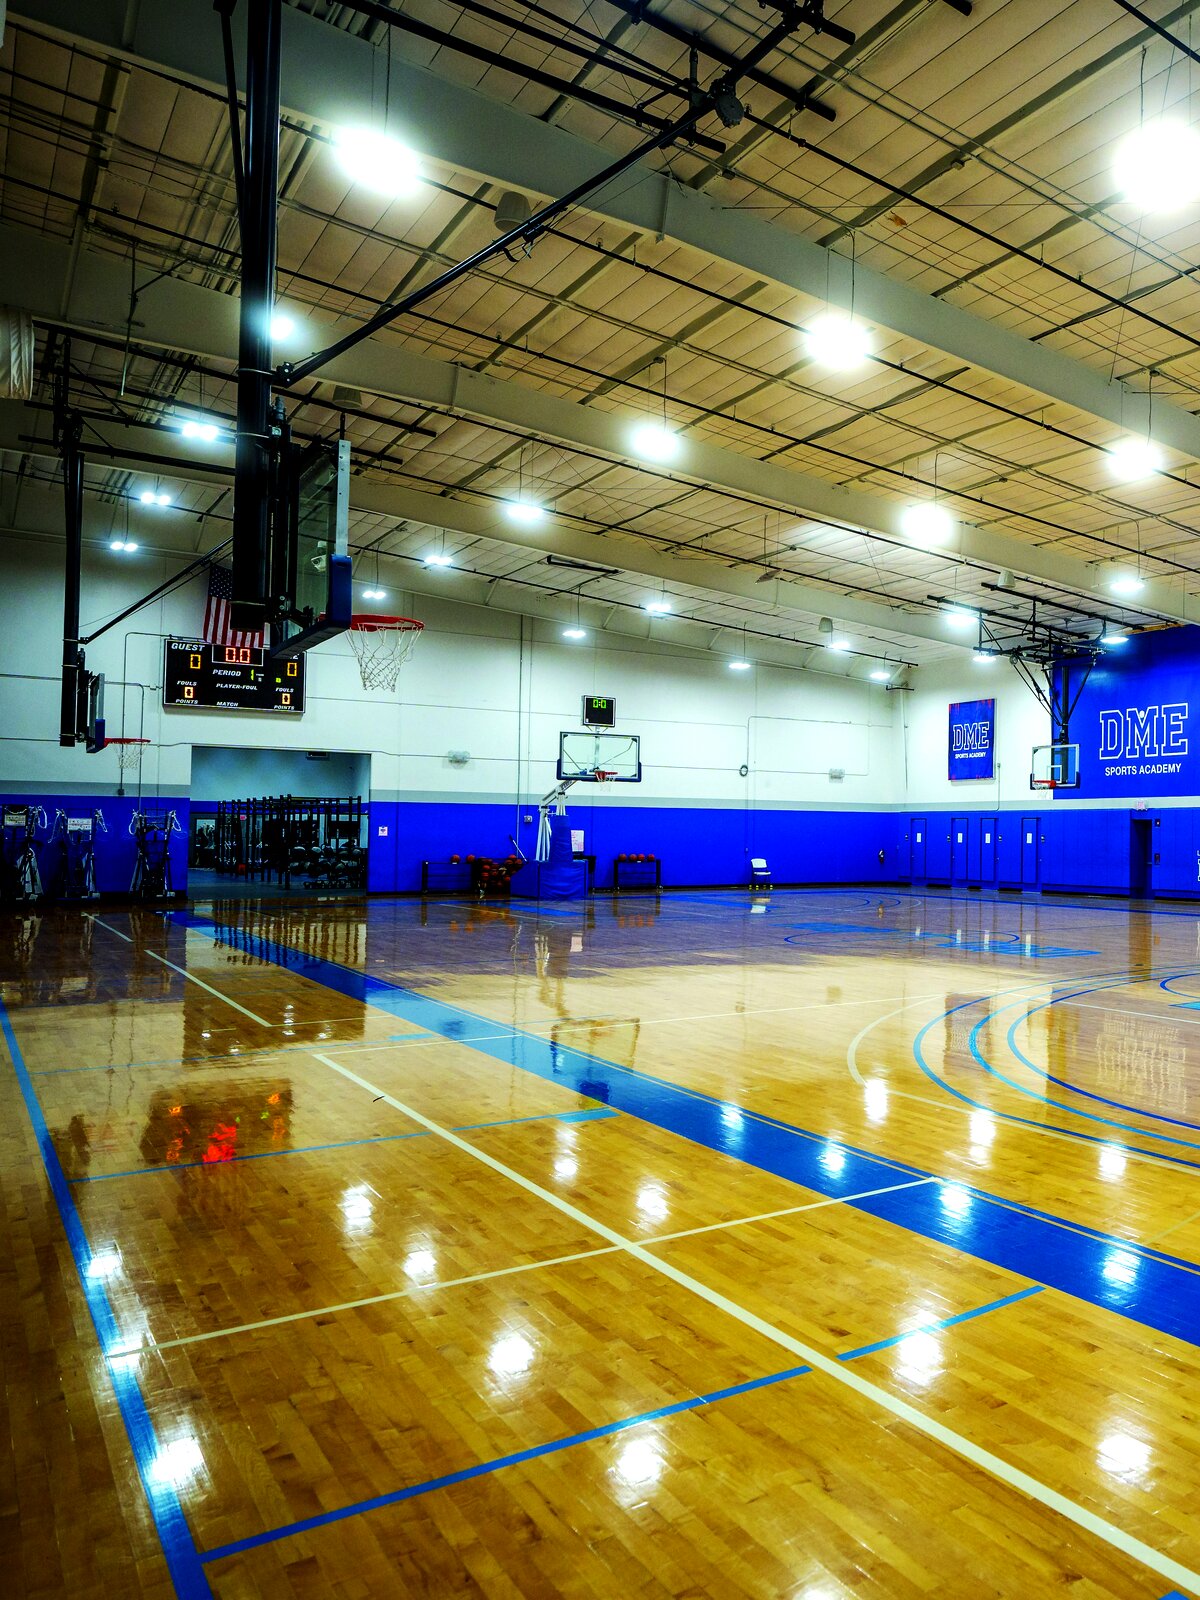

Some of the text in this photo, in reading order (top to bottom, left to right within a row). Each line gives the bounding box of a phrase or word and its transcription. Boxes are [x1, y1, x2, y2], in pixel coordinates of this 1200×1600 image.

[171, 643, 205, 652] GUEST
[190, 654, 201, 669] 0
[212, 669, 242, 677] PERIOD
[287, 662, 298, 677] 0
[216, 683, 258, 691] PLAYER-FOUL
[953, 721, 990, 751] DME
[1099, 702, 1189, 760] DME
[1105, 763, 1182, 777] SPORTS ACADEMY
